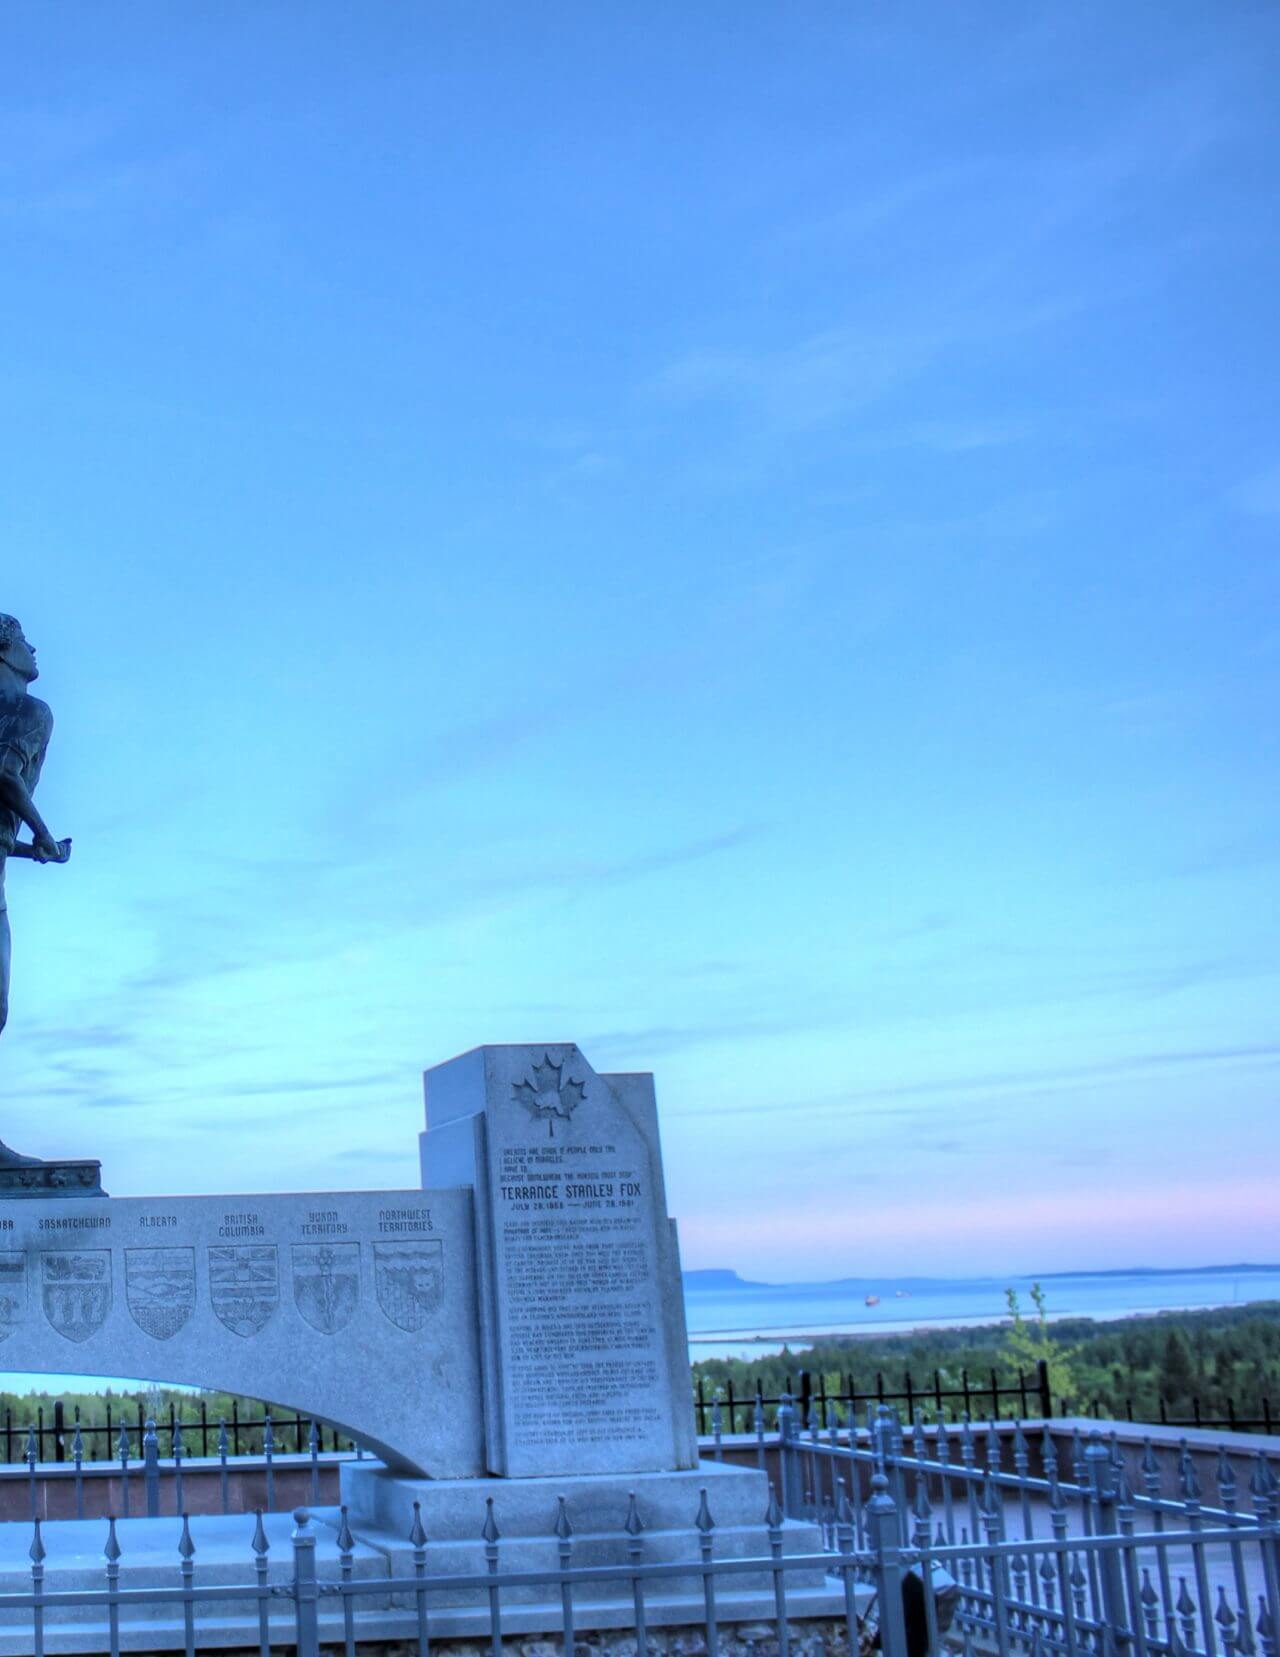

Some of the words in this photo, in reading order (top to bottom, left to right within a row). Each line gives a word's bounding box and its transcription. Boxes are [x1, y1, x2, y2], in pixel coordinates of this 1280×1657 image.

[501, 1186, 558, 1200] TERRANCE
[566, 1184, 613, 1199] STANLEY
[620, 1183, 641, 1197] FOX
[511, 1202, 529, 1211] JULY
[224, 1213, 258, 1225] BRITISH
[309, 1211, 338, 1222] YUKON
[379, 1209, 431, 1221] NORTHWEST
[38, 1217, 111, 1230] SASKATCHEWAN
[139, 1216, 177, 1227] ALBERTA
[378, 1221, 433, 1233] TERRITORIES
[218, 1226, 265, 1238] COLUMBIA
[301, 1223, 348, 1235] TERRITORY
